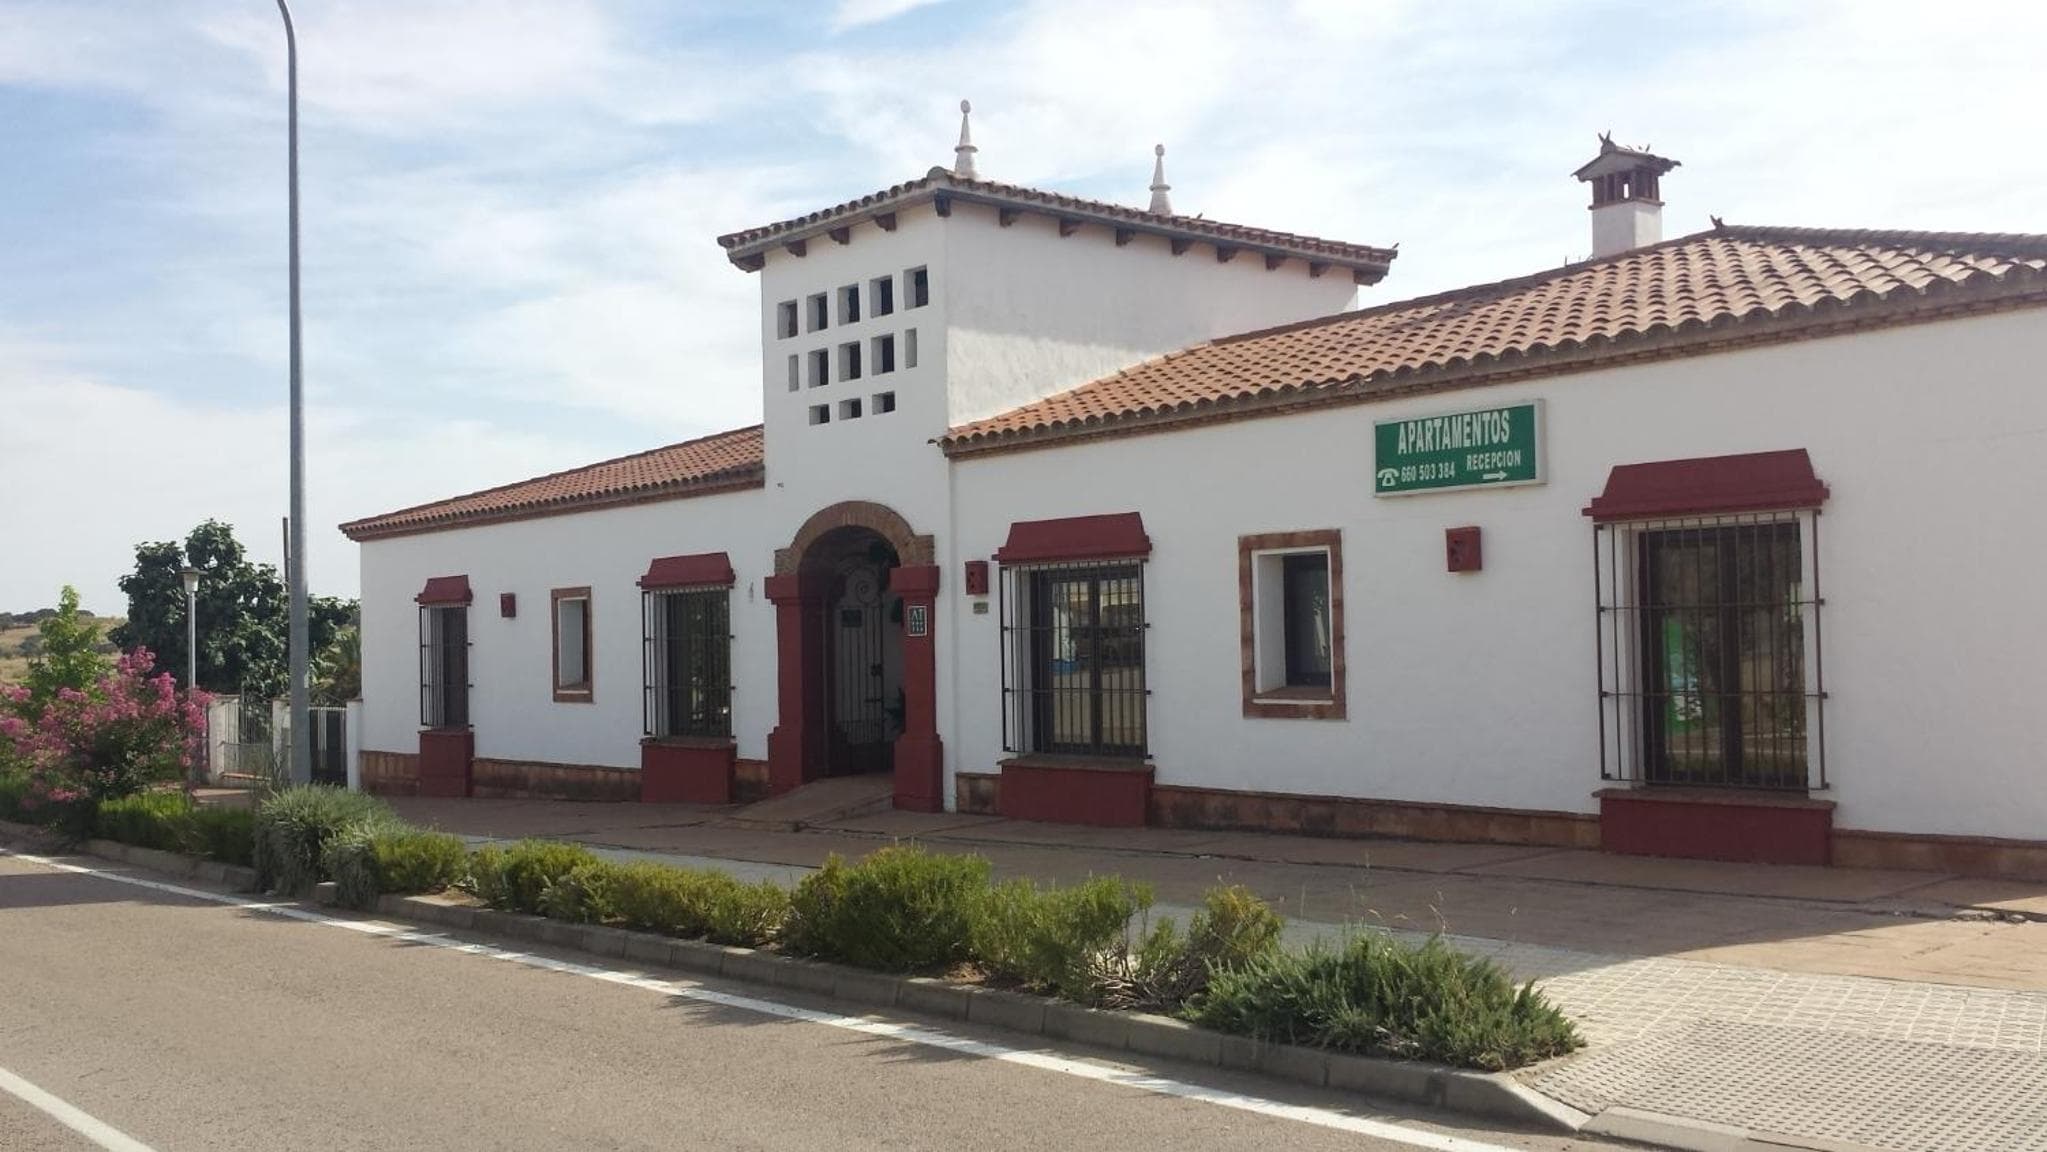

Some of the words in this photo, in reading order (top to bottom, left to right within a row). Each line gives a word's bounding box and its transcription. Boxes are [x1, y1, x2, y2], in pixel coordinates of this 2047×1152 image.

[1398, 410, 1510, 454] APARTAMENTOS
[1419, 463, 1436, 480] 503
[1438, 461, 1455, 479] 384
[1466, 450, 1521, 471] RECEPCION
